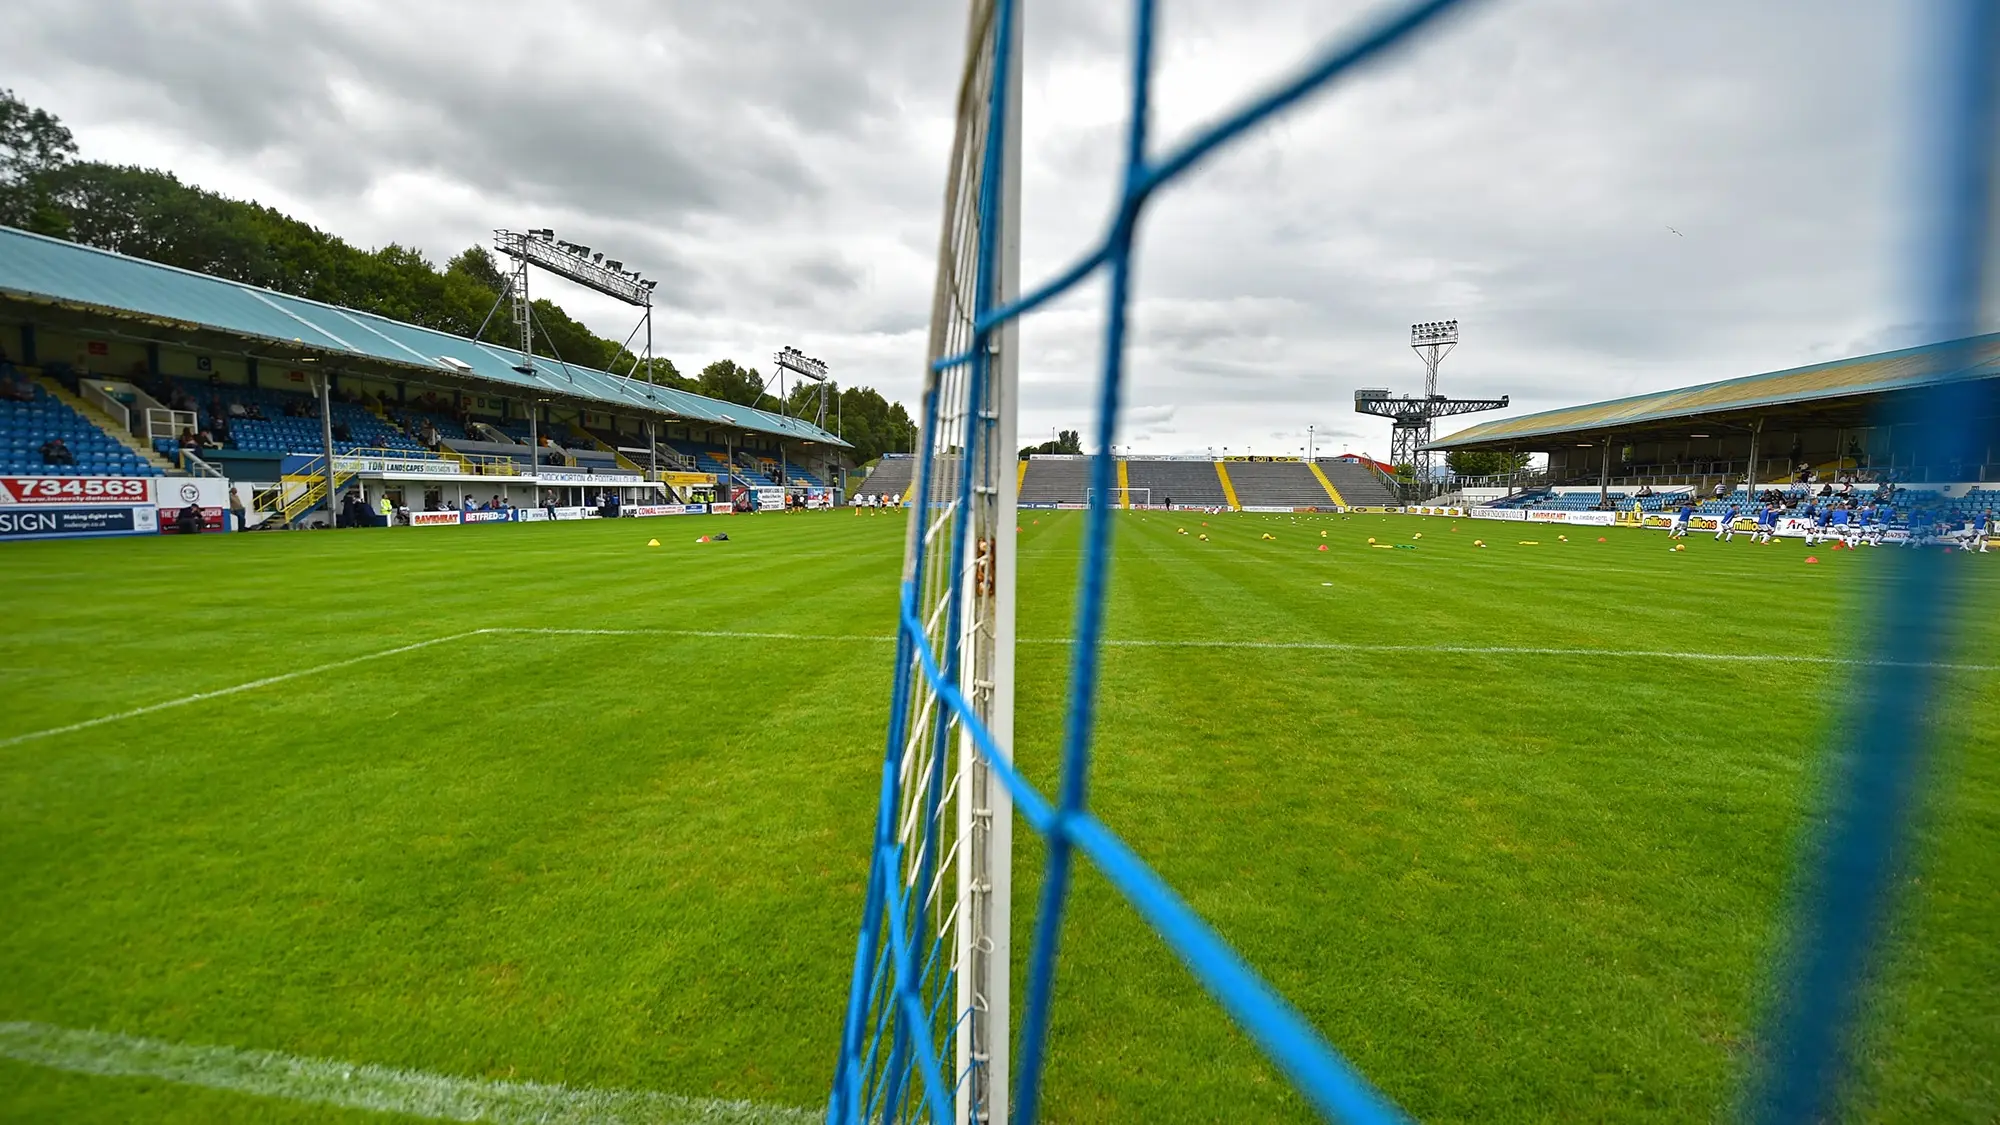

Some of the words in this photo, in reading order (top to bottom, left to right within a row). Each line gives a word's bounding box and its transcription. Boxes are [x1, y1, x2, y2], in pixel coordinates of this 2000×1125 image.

[560, 473, 585, 482] MORTON
[17, 480, 144, 496] 734563
[63, 513, 88, 521] Making
[466, 511, 498, 521] BETFRED
[1643, 517, 1672, 528] millions
[1733, 520, 1760, 531] millio
